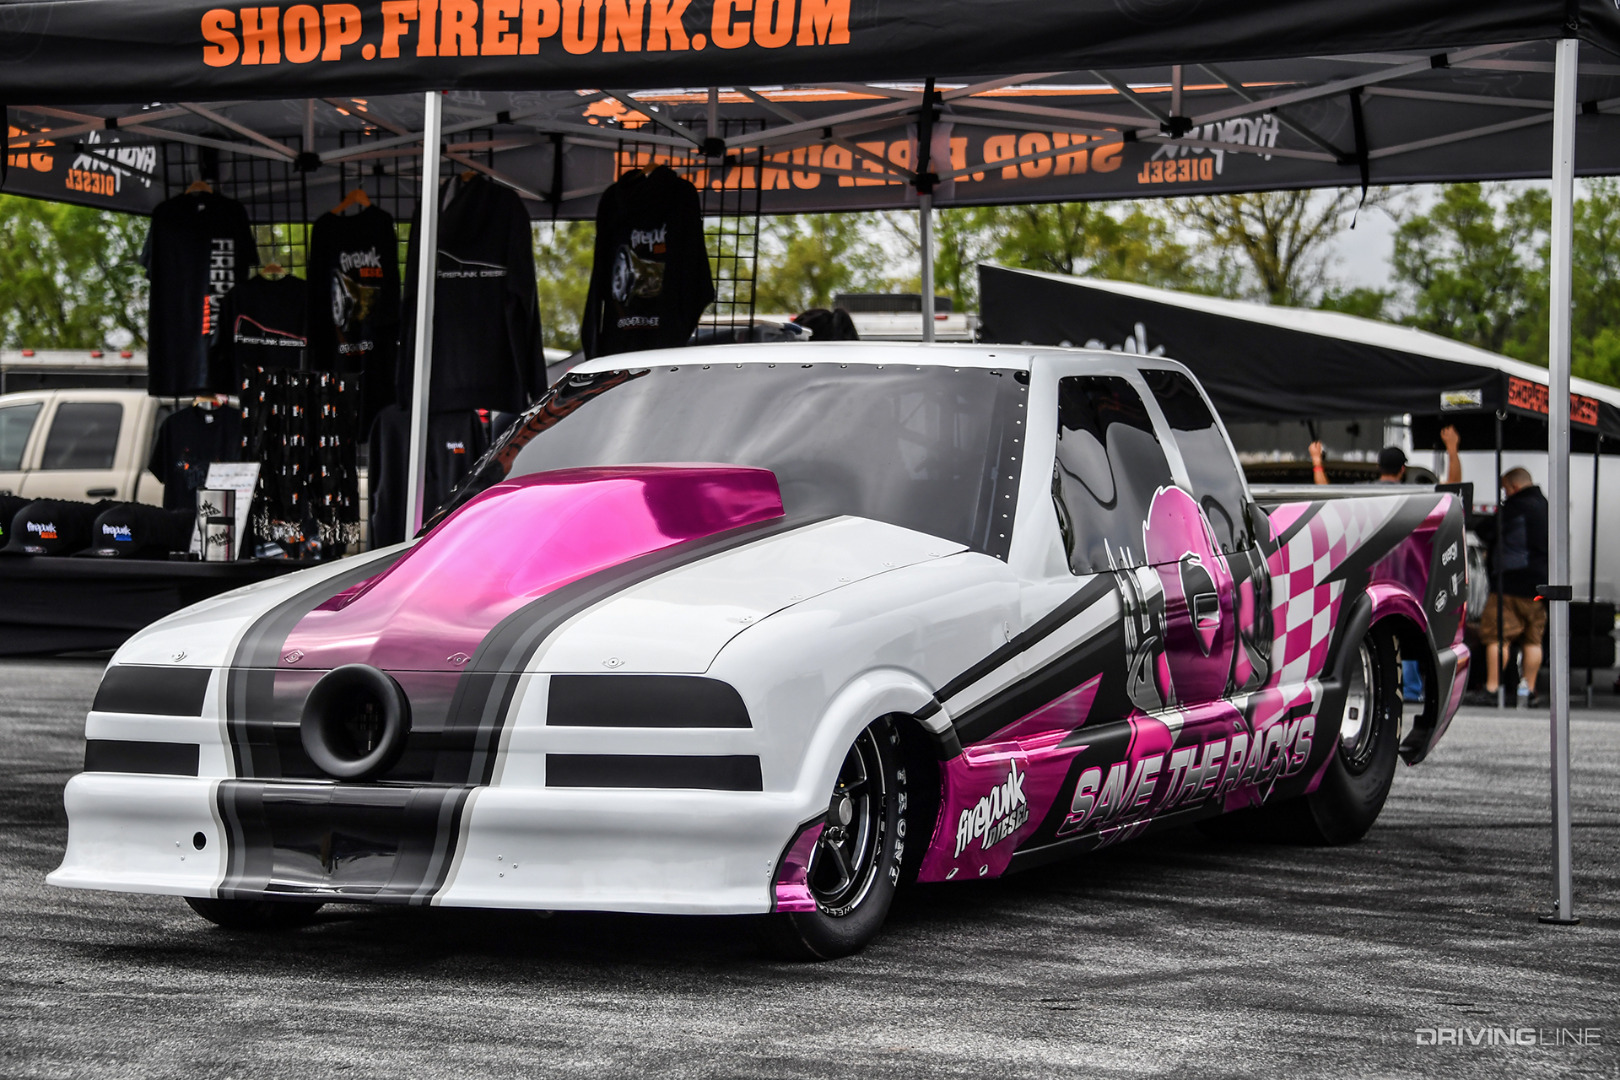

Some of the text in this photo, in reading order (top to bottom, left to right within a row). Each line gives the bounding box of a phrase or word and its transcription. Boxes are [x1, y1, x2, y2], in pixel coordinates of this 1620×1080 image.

[200, 0, 851, 67] SHOP.FIREPUNK.COM
[953, 757, 1026, 859] firepunk
[1056, 714, 1316, 837] SAVE THE RACKS
[985, 801, 1029, 850] DIESEL
